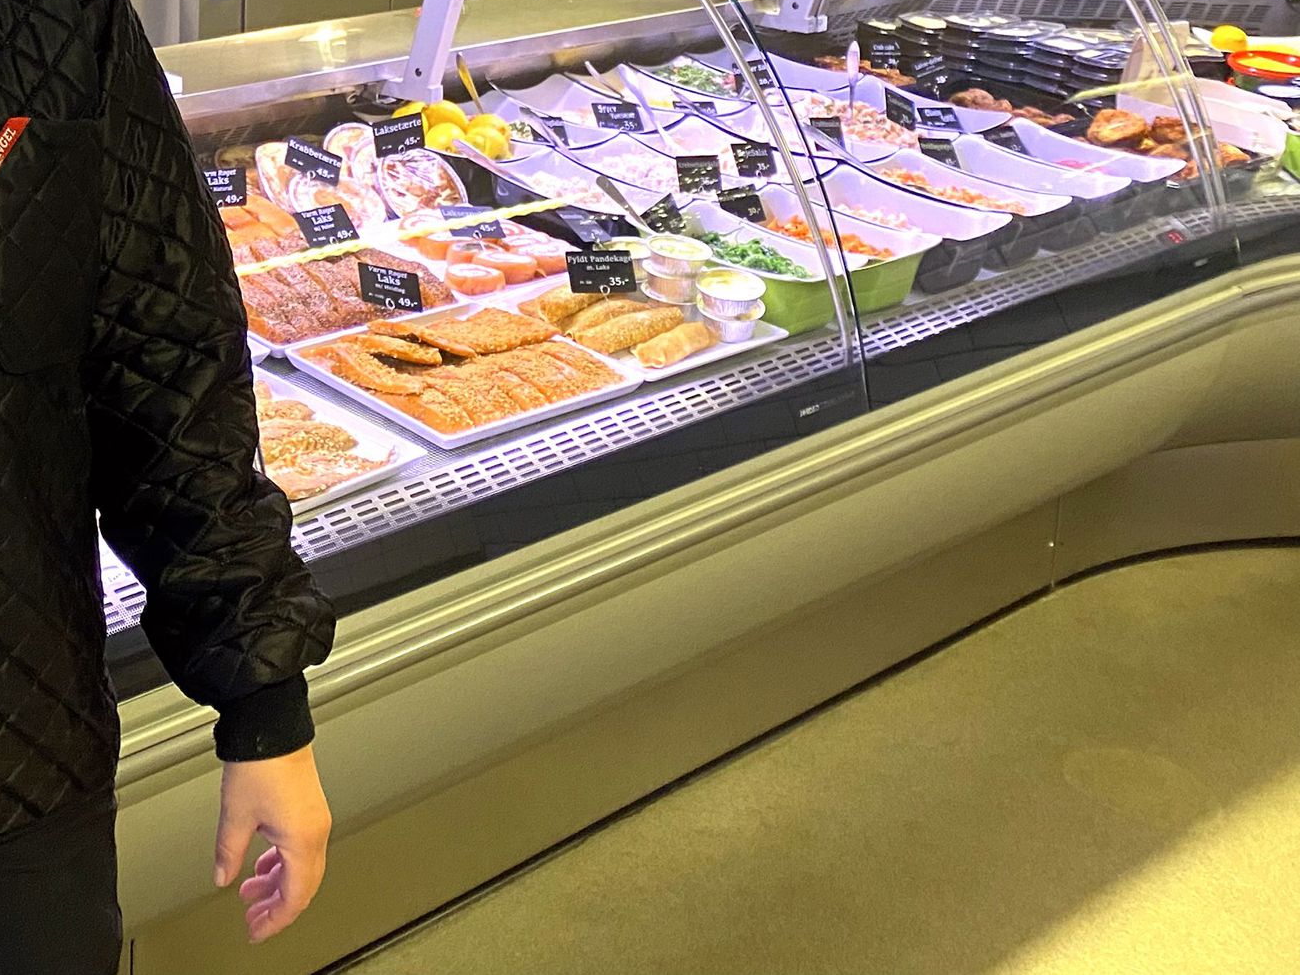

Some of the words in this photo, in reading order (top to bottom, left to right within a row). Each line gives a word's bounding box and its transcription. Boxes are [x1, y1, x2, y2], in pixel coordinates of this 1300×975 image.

[207, 177, 229, 185] Laks
[311, 215, 333, 225] Laks
[368, 266, 387, 274] Varm
[377, 274, 401, 285] Laks
[609, 277, 629, 286] 35,-
[398, 297, 418, 307] 49,-
